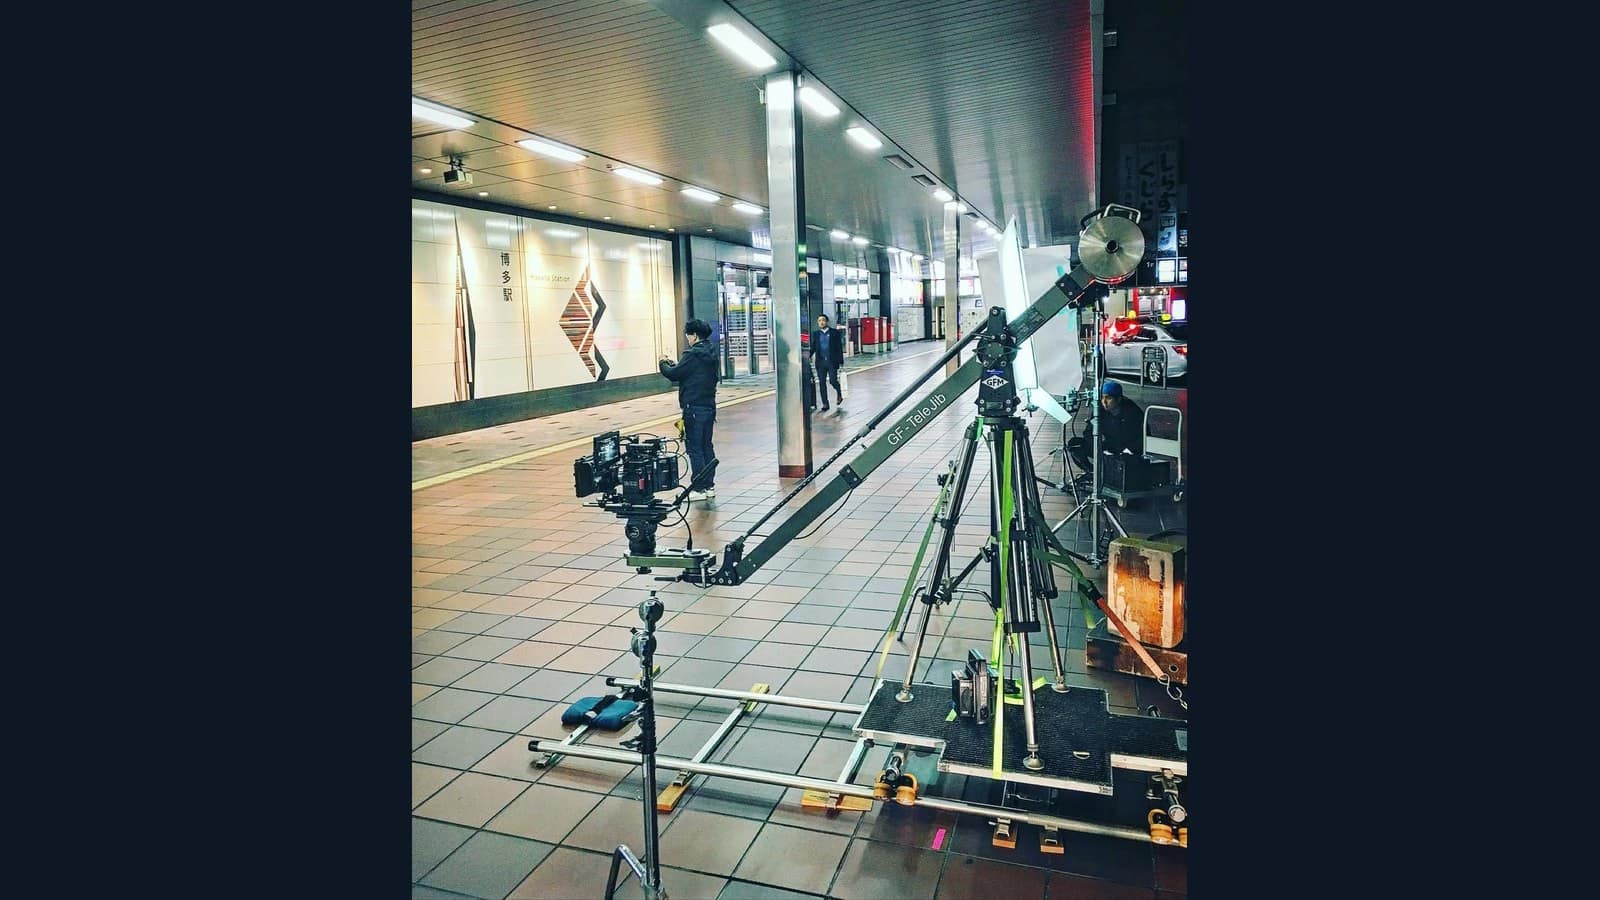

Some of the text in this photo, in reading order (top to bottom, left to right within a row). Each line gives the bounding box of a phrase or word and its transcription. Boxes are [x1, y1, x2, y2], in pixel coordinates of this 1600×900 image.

[500, 252, 513, 302] 博多駅
[986, 378, 1004, 387] GFM
